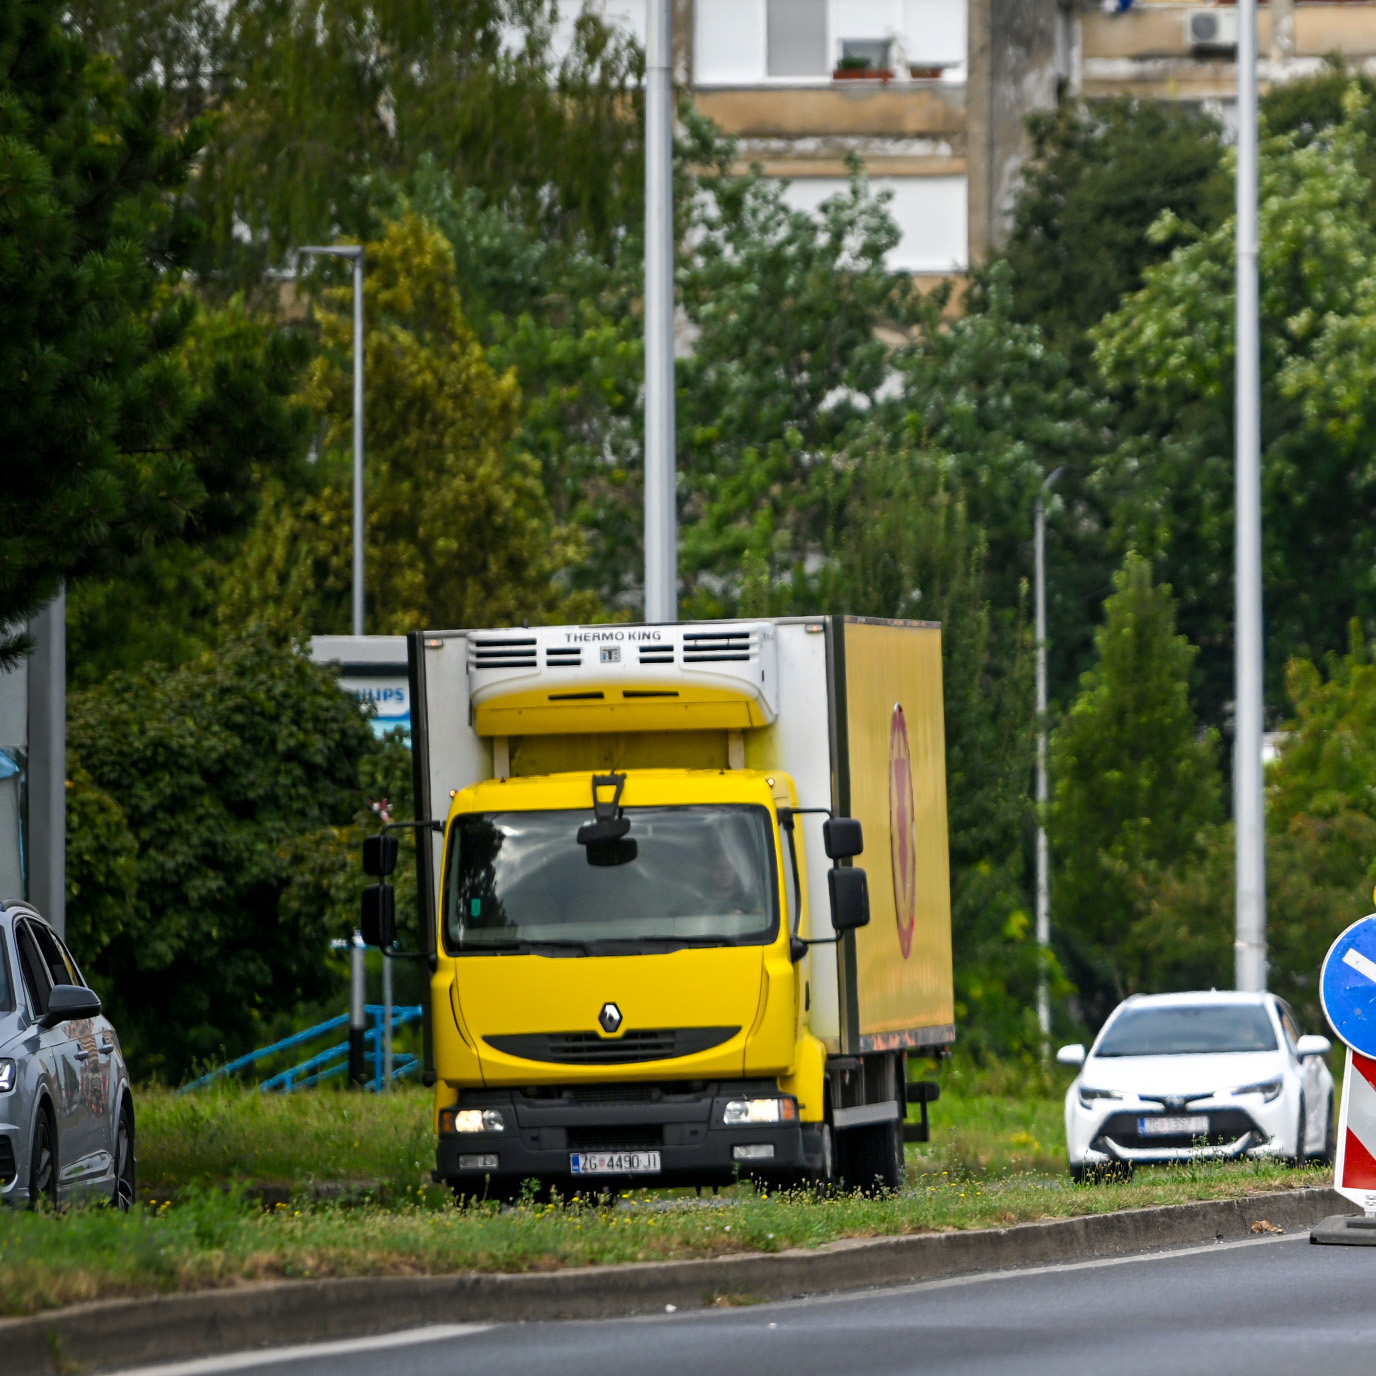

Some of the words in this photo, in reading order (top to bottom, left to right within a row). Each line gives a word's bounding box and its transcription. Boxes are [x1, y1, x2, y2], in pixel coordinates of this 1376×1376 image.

[564, 630, 625, 643] THERMO
[629, 629, 662, 642] KING
[580, 1154, 597, 1171] ZG
